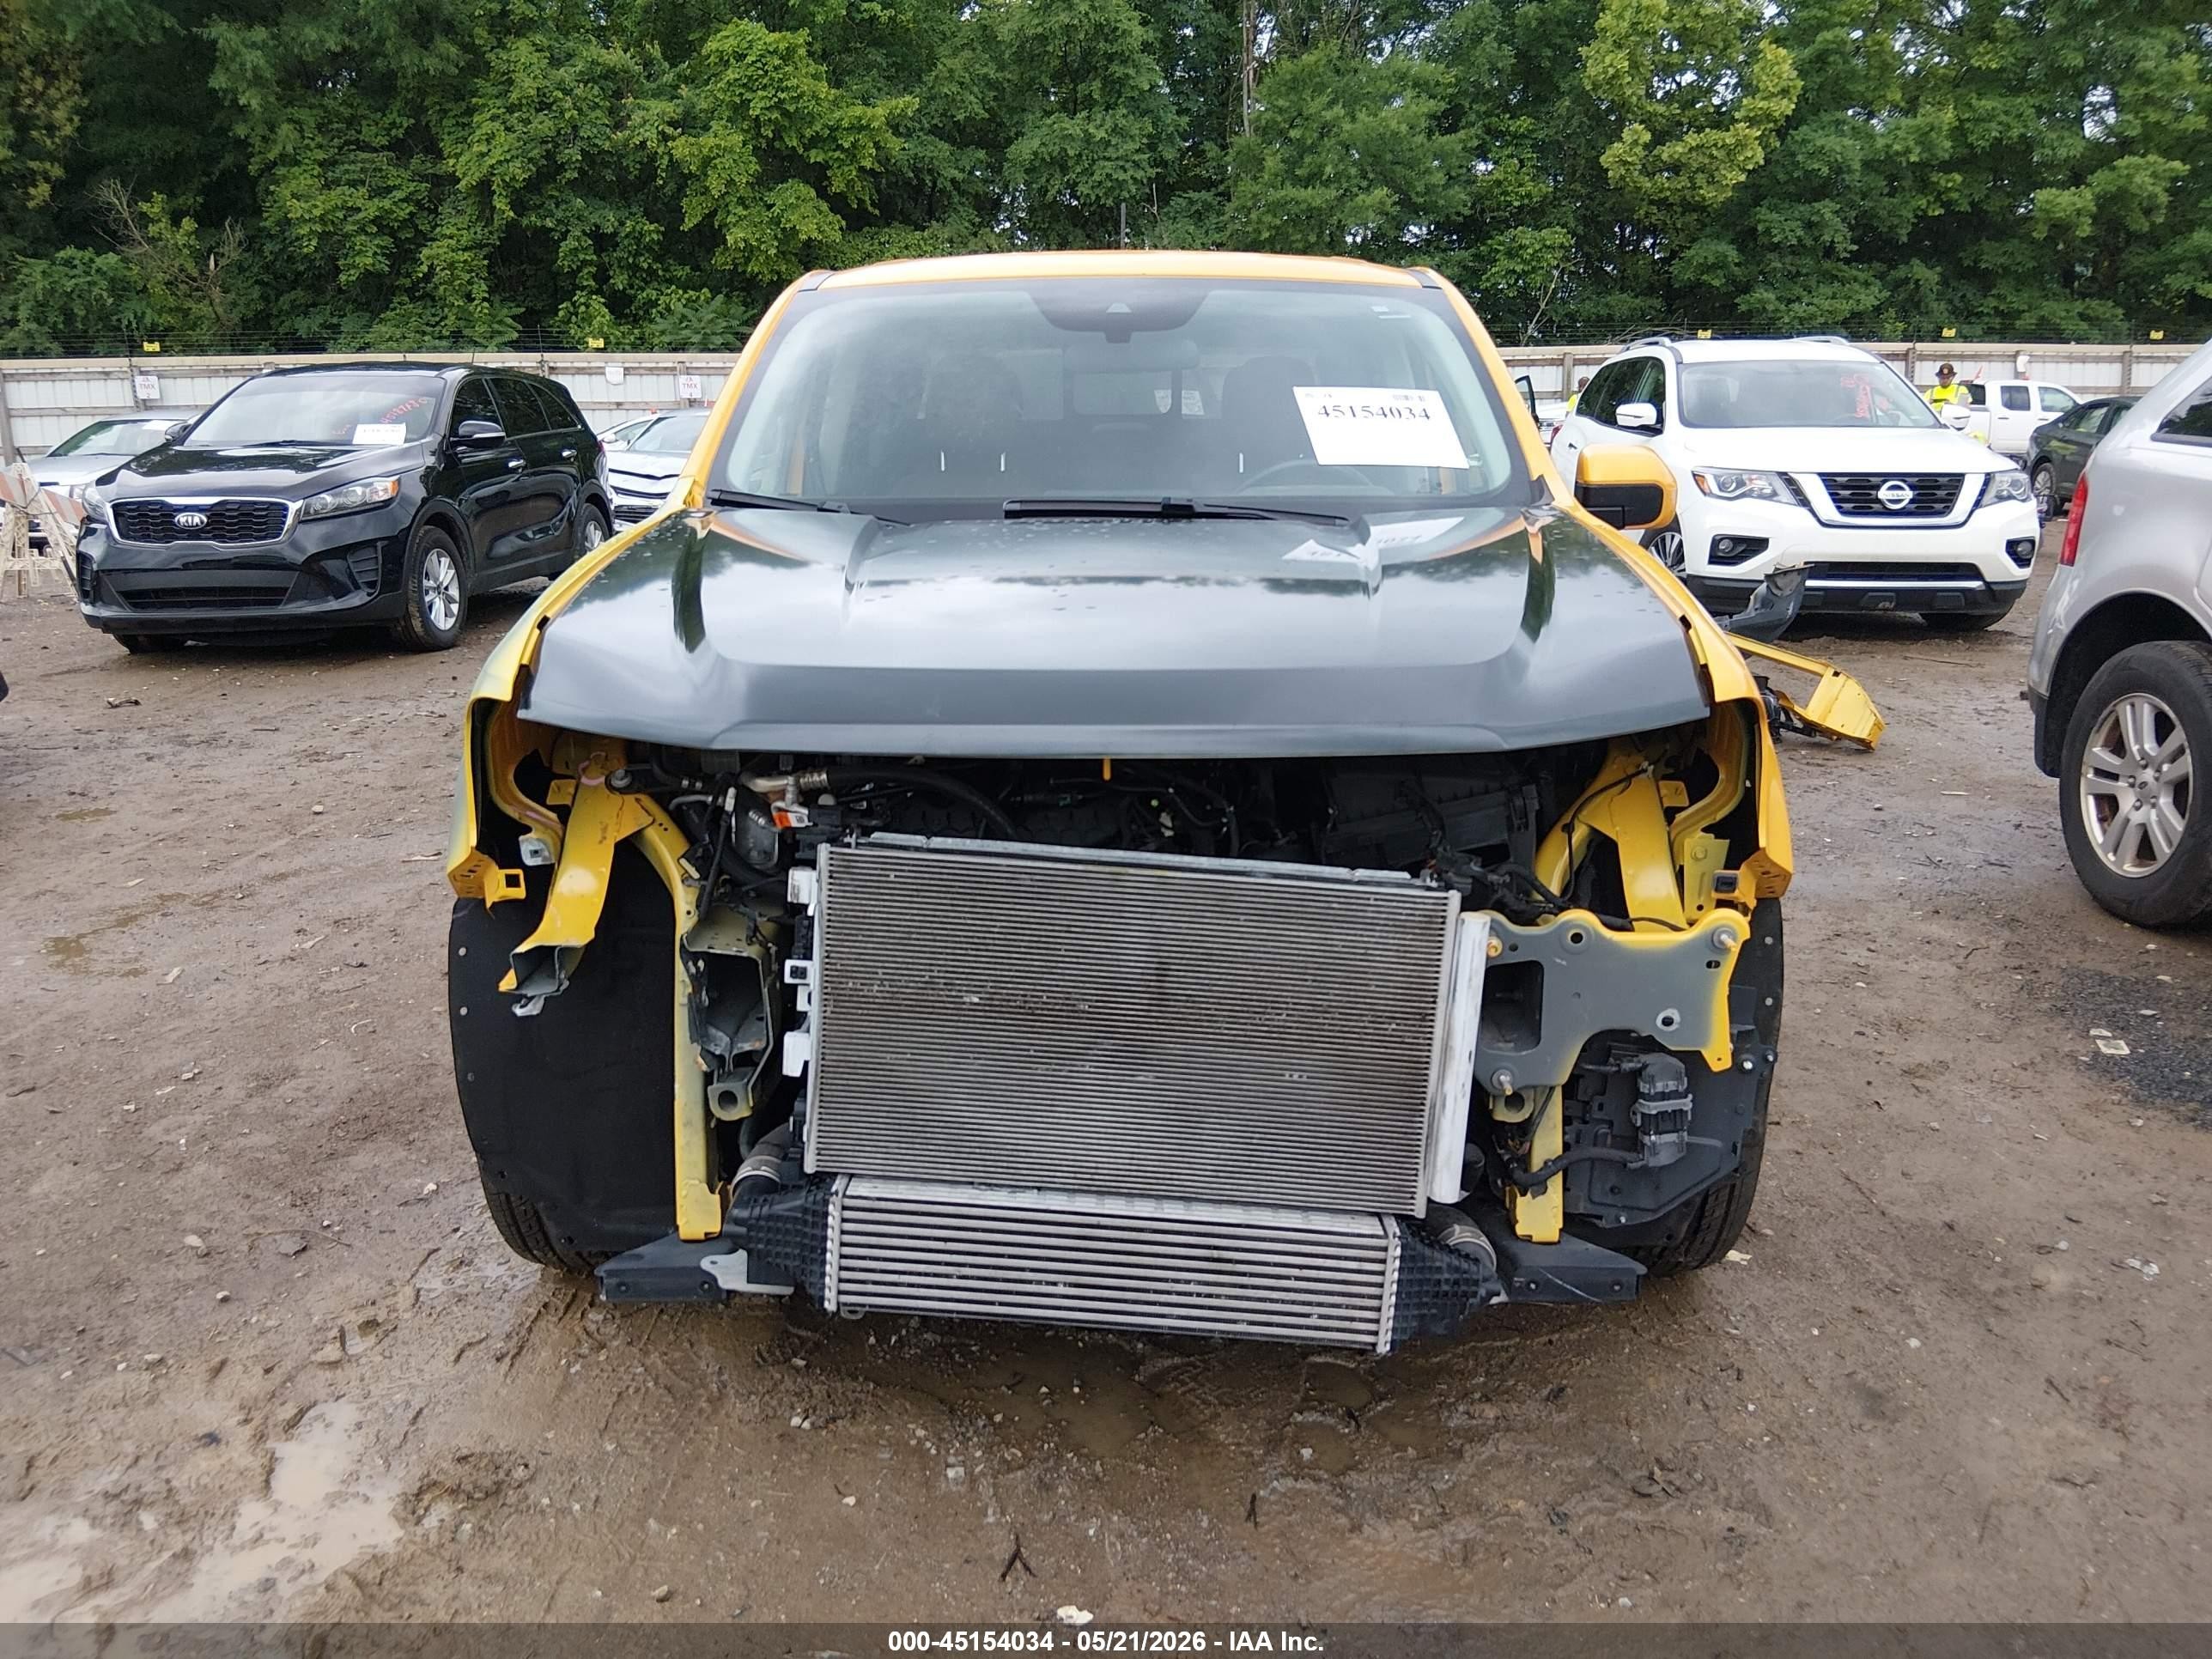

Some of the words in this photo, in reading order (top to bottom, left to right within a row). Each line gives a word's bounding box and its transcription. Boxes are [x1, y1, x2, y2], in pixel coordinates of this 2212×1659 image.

[138, 383, 157, 392] TMX
[1318, 404, 1431, 421] 45154034
[179, 515, 202, 526] KIA
